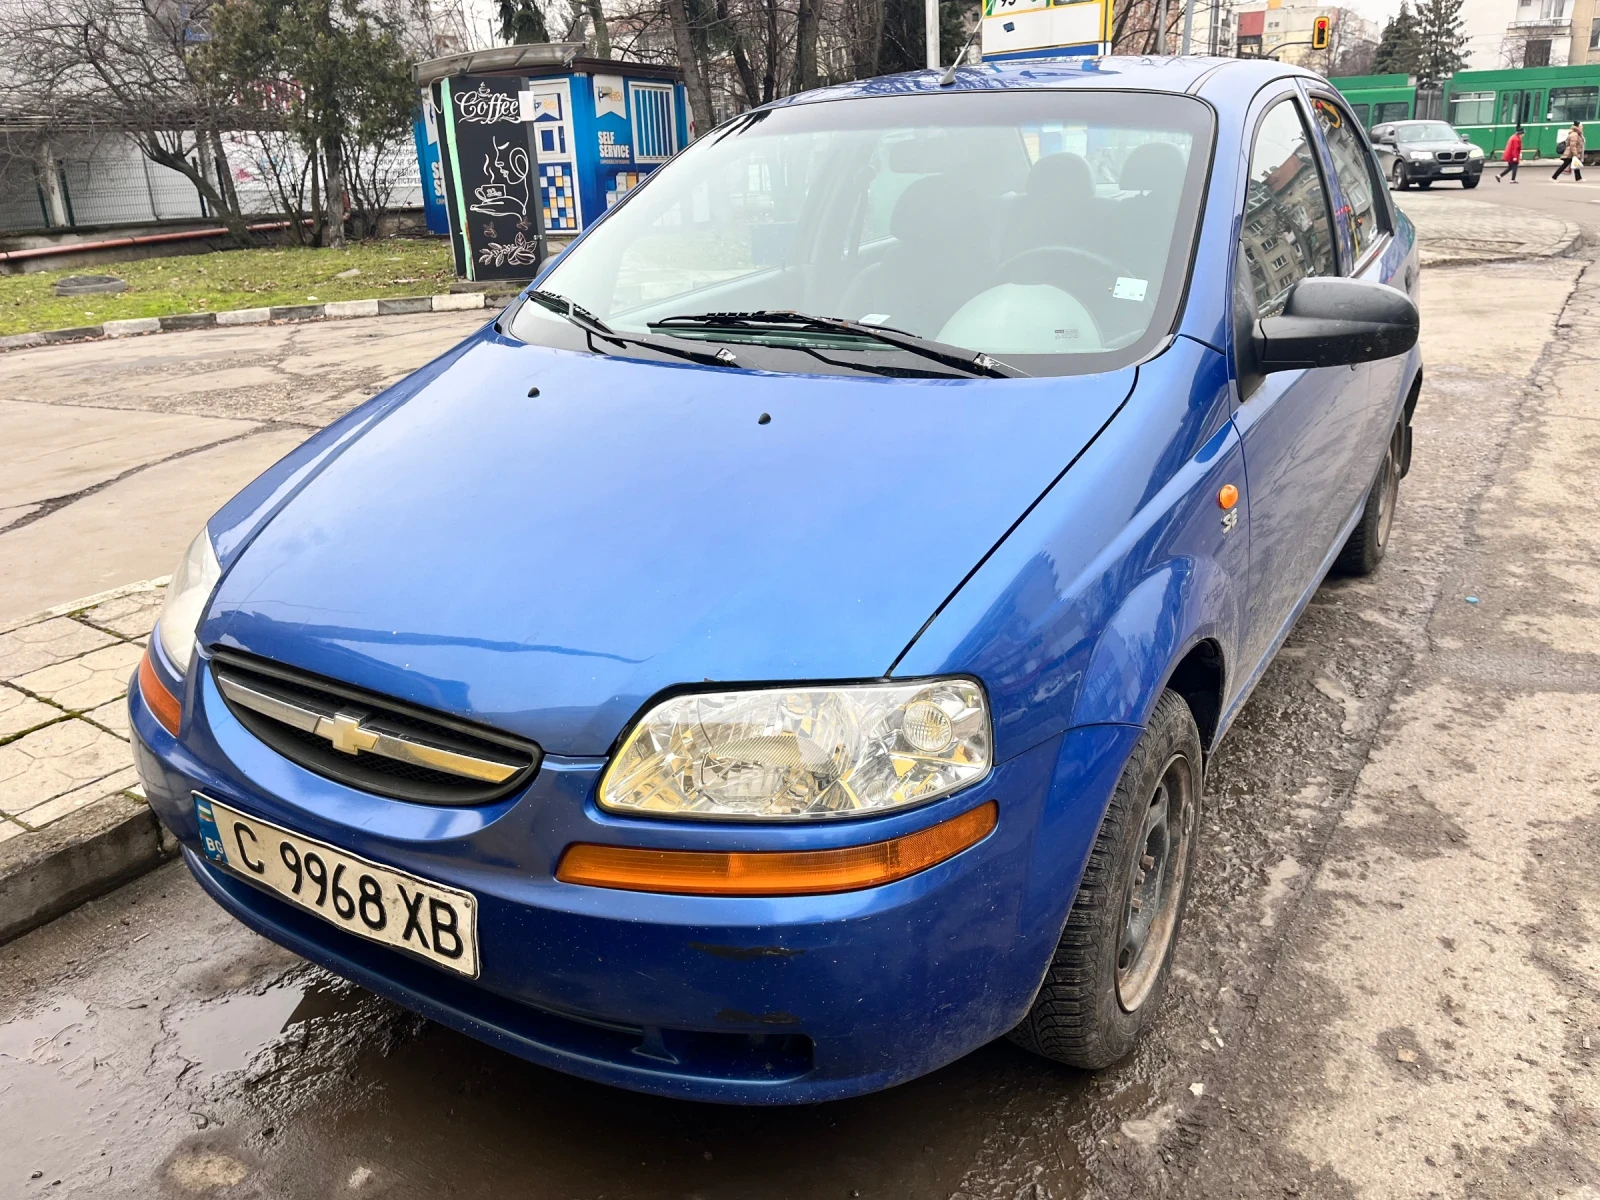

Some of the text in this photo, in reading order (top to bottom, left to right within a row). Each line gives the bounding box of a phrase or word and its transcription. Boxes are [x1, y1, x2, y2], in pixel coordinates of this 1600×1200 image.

[454, 91, 519, 124] Coffee
[597, 131, 615, 144] SELF
[599, 145, 630, 158] SERVICE
[205, 836, 224, 854] BG
[233, 821, 463, 959] C 9968 XB
